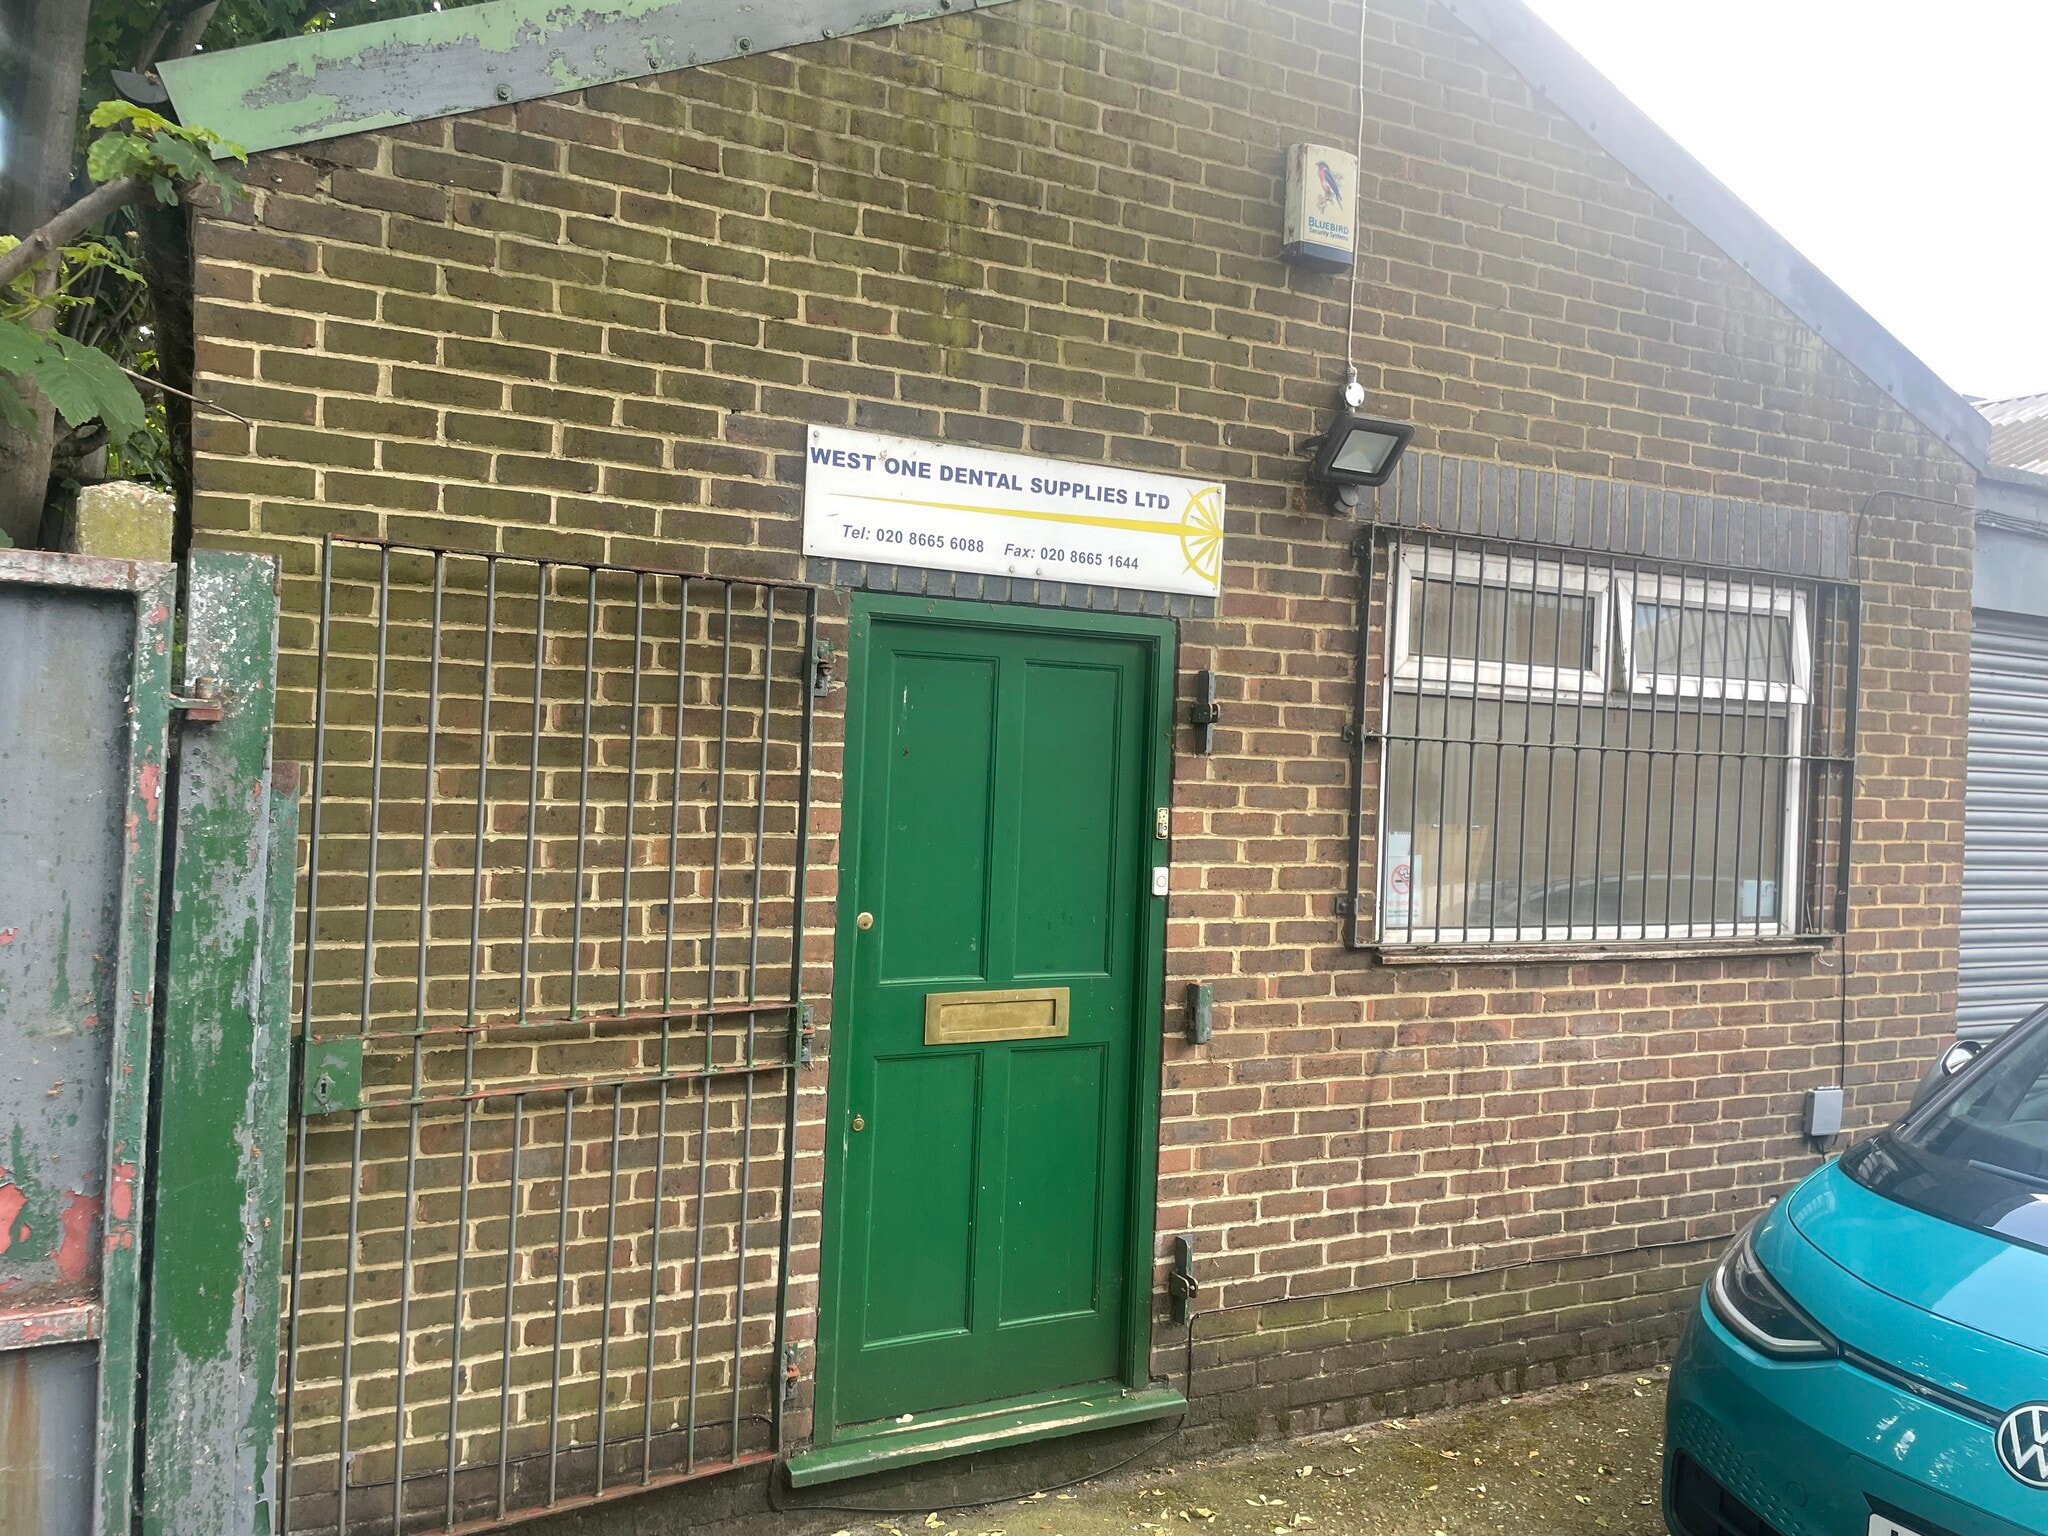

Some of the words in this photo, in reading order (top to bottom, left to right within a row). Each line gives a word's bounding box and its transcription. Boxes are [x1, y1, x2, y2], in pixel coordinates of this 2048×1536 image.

[1308, 216, 1349, 235] BLUEBIRD
[811, 446, 877, 472] WEST
[884, 457, 932, 480] ONE
[939, 464, 1023, 492] DENTAL
[1030, 477, 1128, 505] SUPPLIES
[1134, 491, 1171, 510] LTD
[842, 524, 871, 540] Tel:
[876, 528, 903, 544] 020
[908, 532, 945, 549] 8665
[950, 536, 985, 553] 6088
[1004, 543, 1036, 559] Fax:
[1040, 547, 1065, 562] 020
[1070, 550, 1103, 566] 8665
[1107, 554, 1139, 570] 1644
